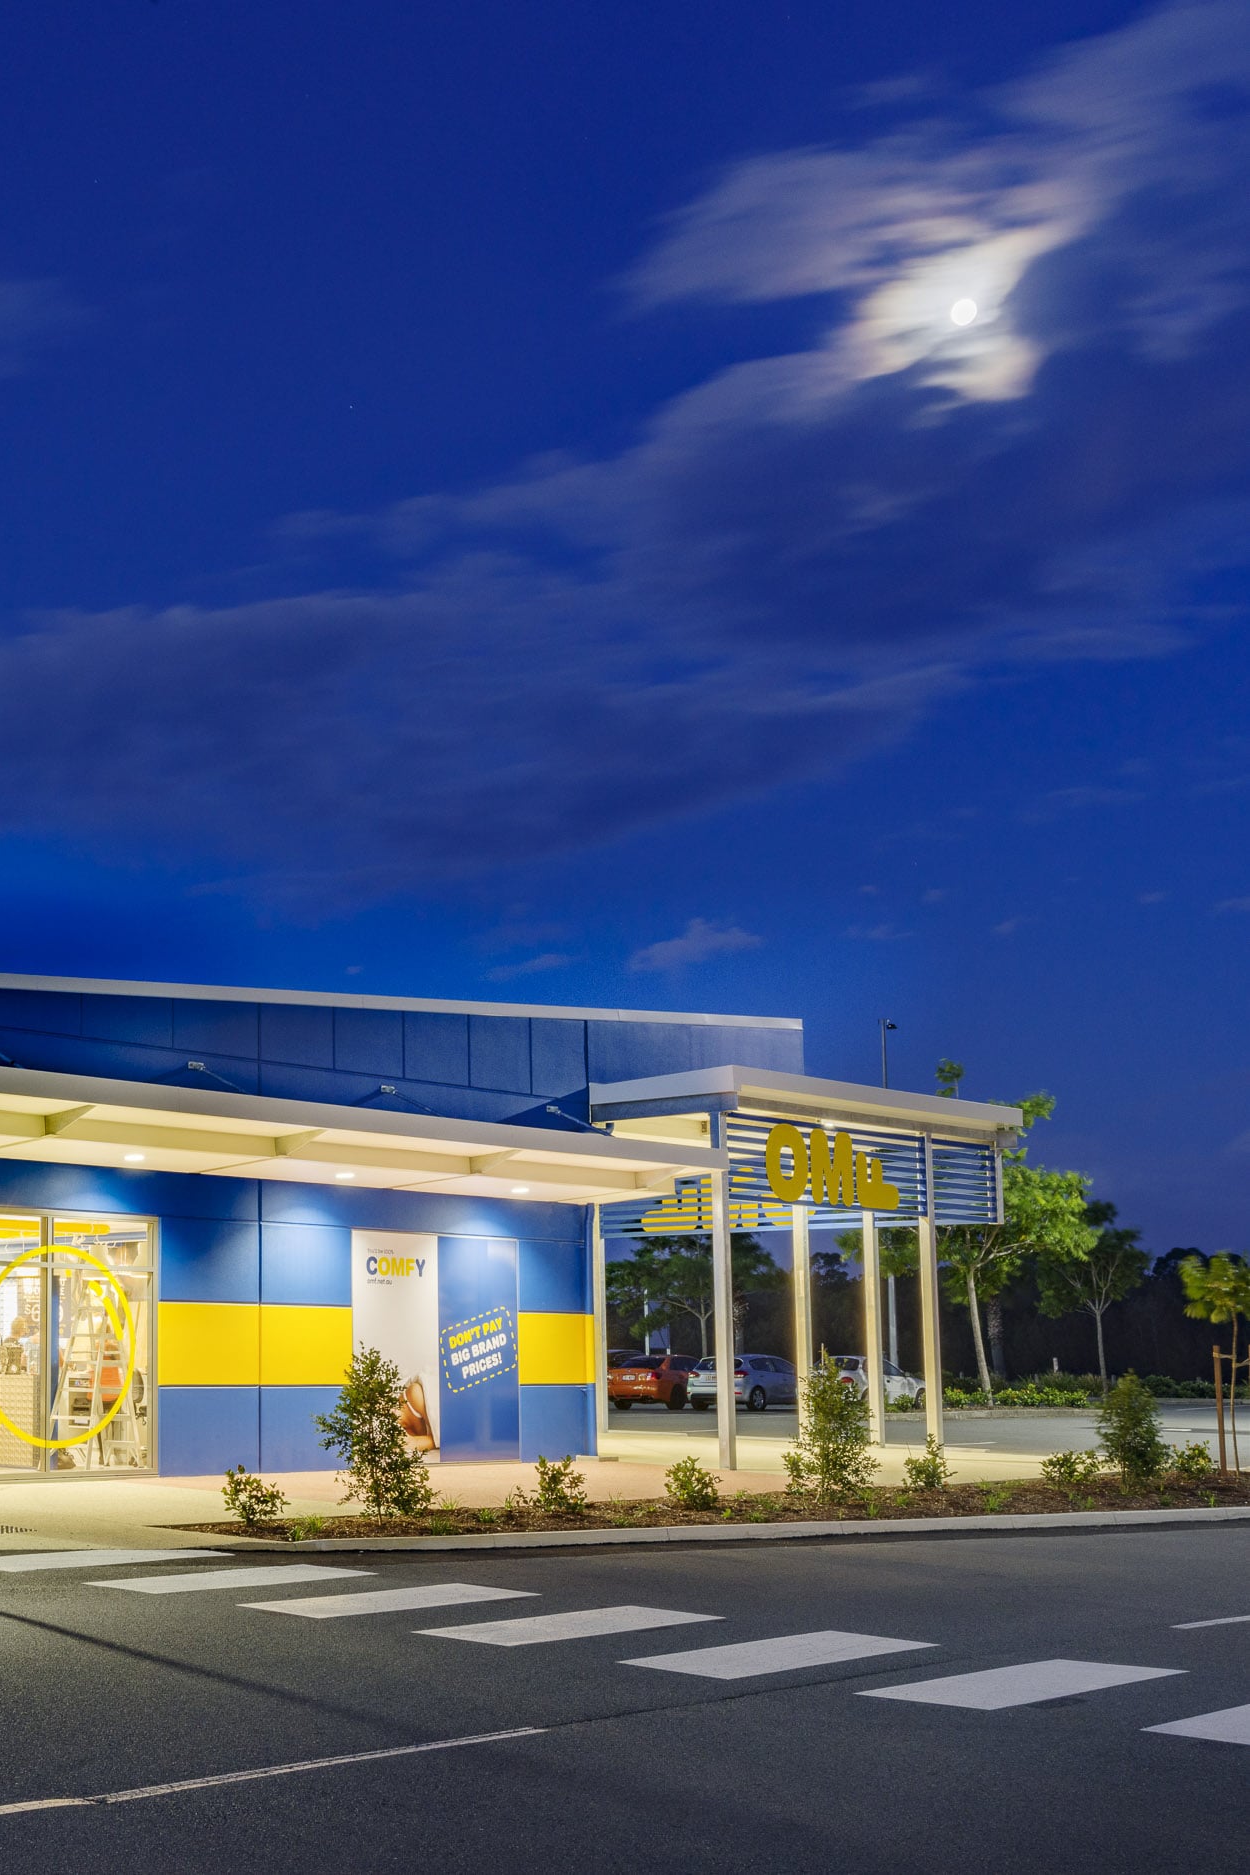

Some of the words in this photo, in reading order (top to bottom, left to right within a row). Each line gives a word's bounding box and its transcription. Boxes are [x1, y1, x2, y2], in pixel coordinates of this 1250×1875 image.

[366, 1256, 425, 1277] COMFY
[449, 1325, 481, 1349] DON'T
[482, 1317, 502, 1336] PAY
[451, 1348, 470, 1366] BIG
[471, 1333, 507, 1357] BRAND
[462, 1352, 502, 1379] PRICES!
